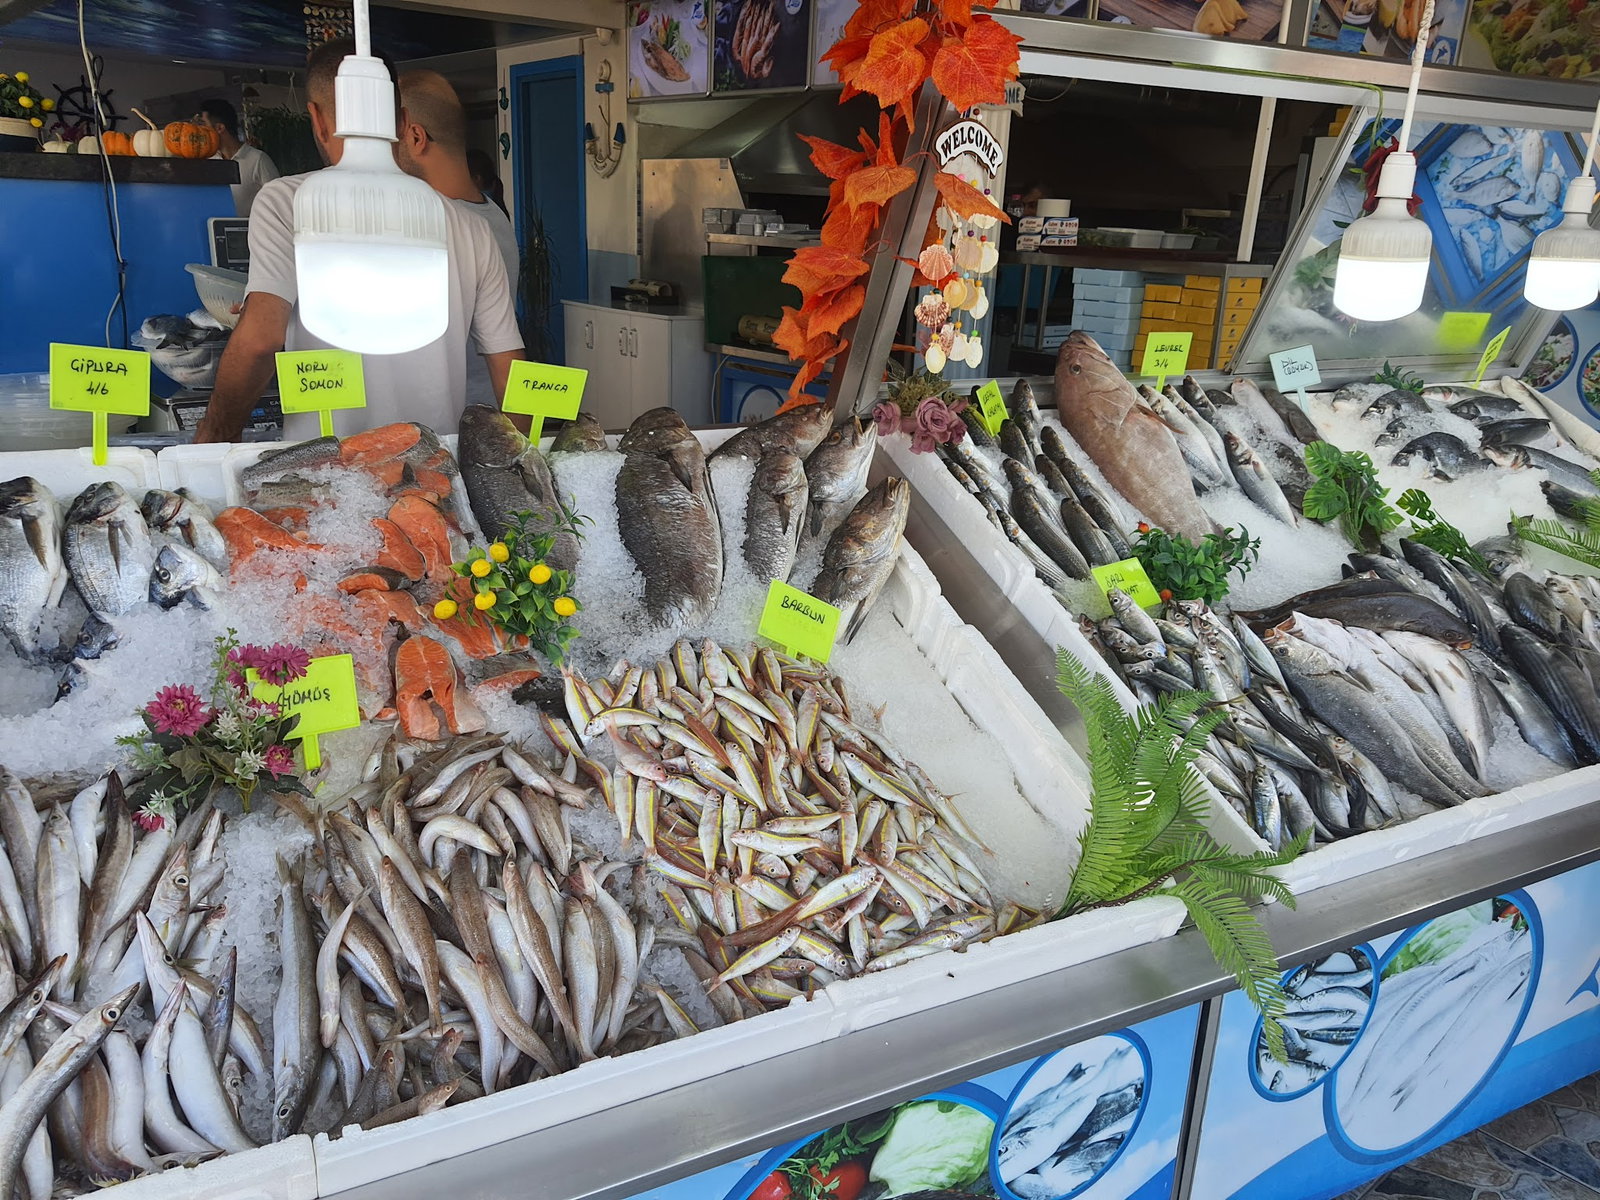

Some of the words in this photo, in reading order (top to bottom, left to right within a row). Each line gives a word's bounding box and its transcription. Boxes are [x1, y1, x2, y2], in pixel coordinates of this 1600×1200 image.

[940, 126, 998, 168] WELCOME
[86, 381, 109, 395] 4/6
[299, 377, 343, 393] SOMON
[780, 595, 826, 625] BARBUN
